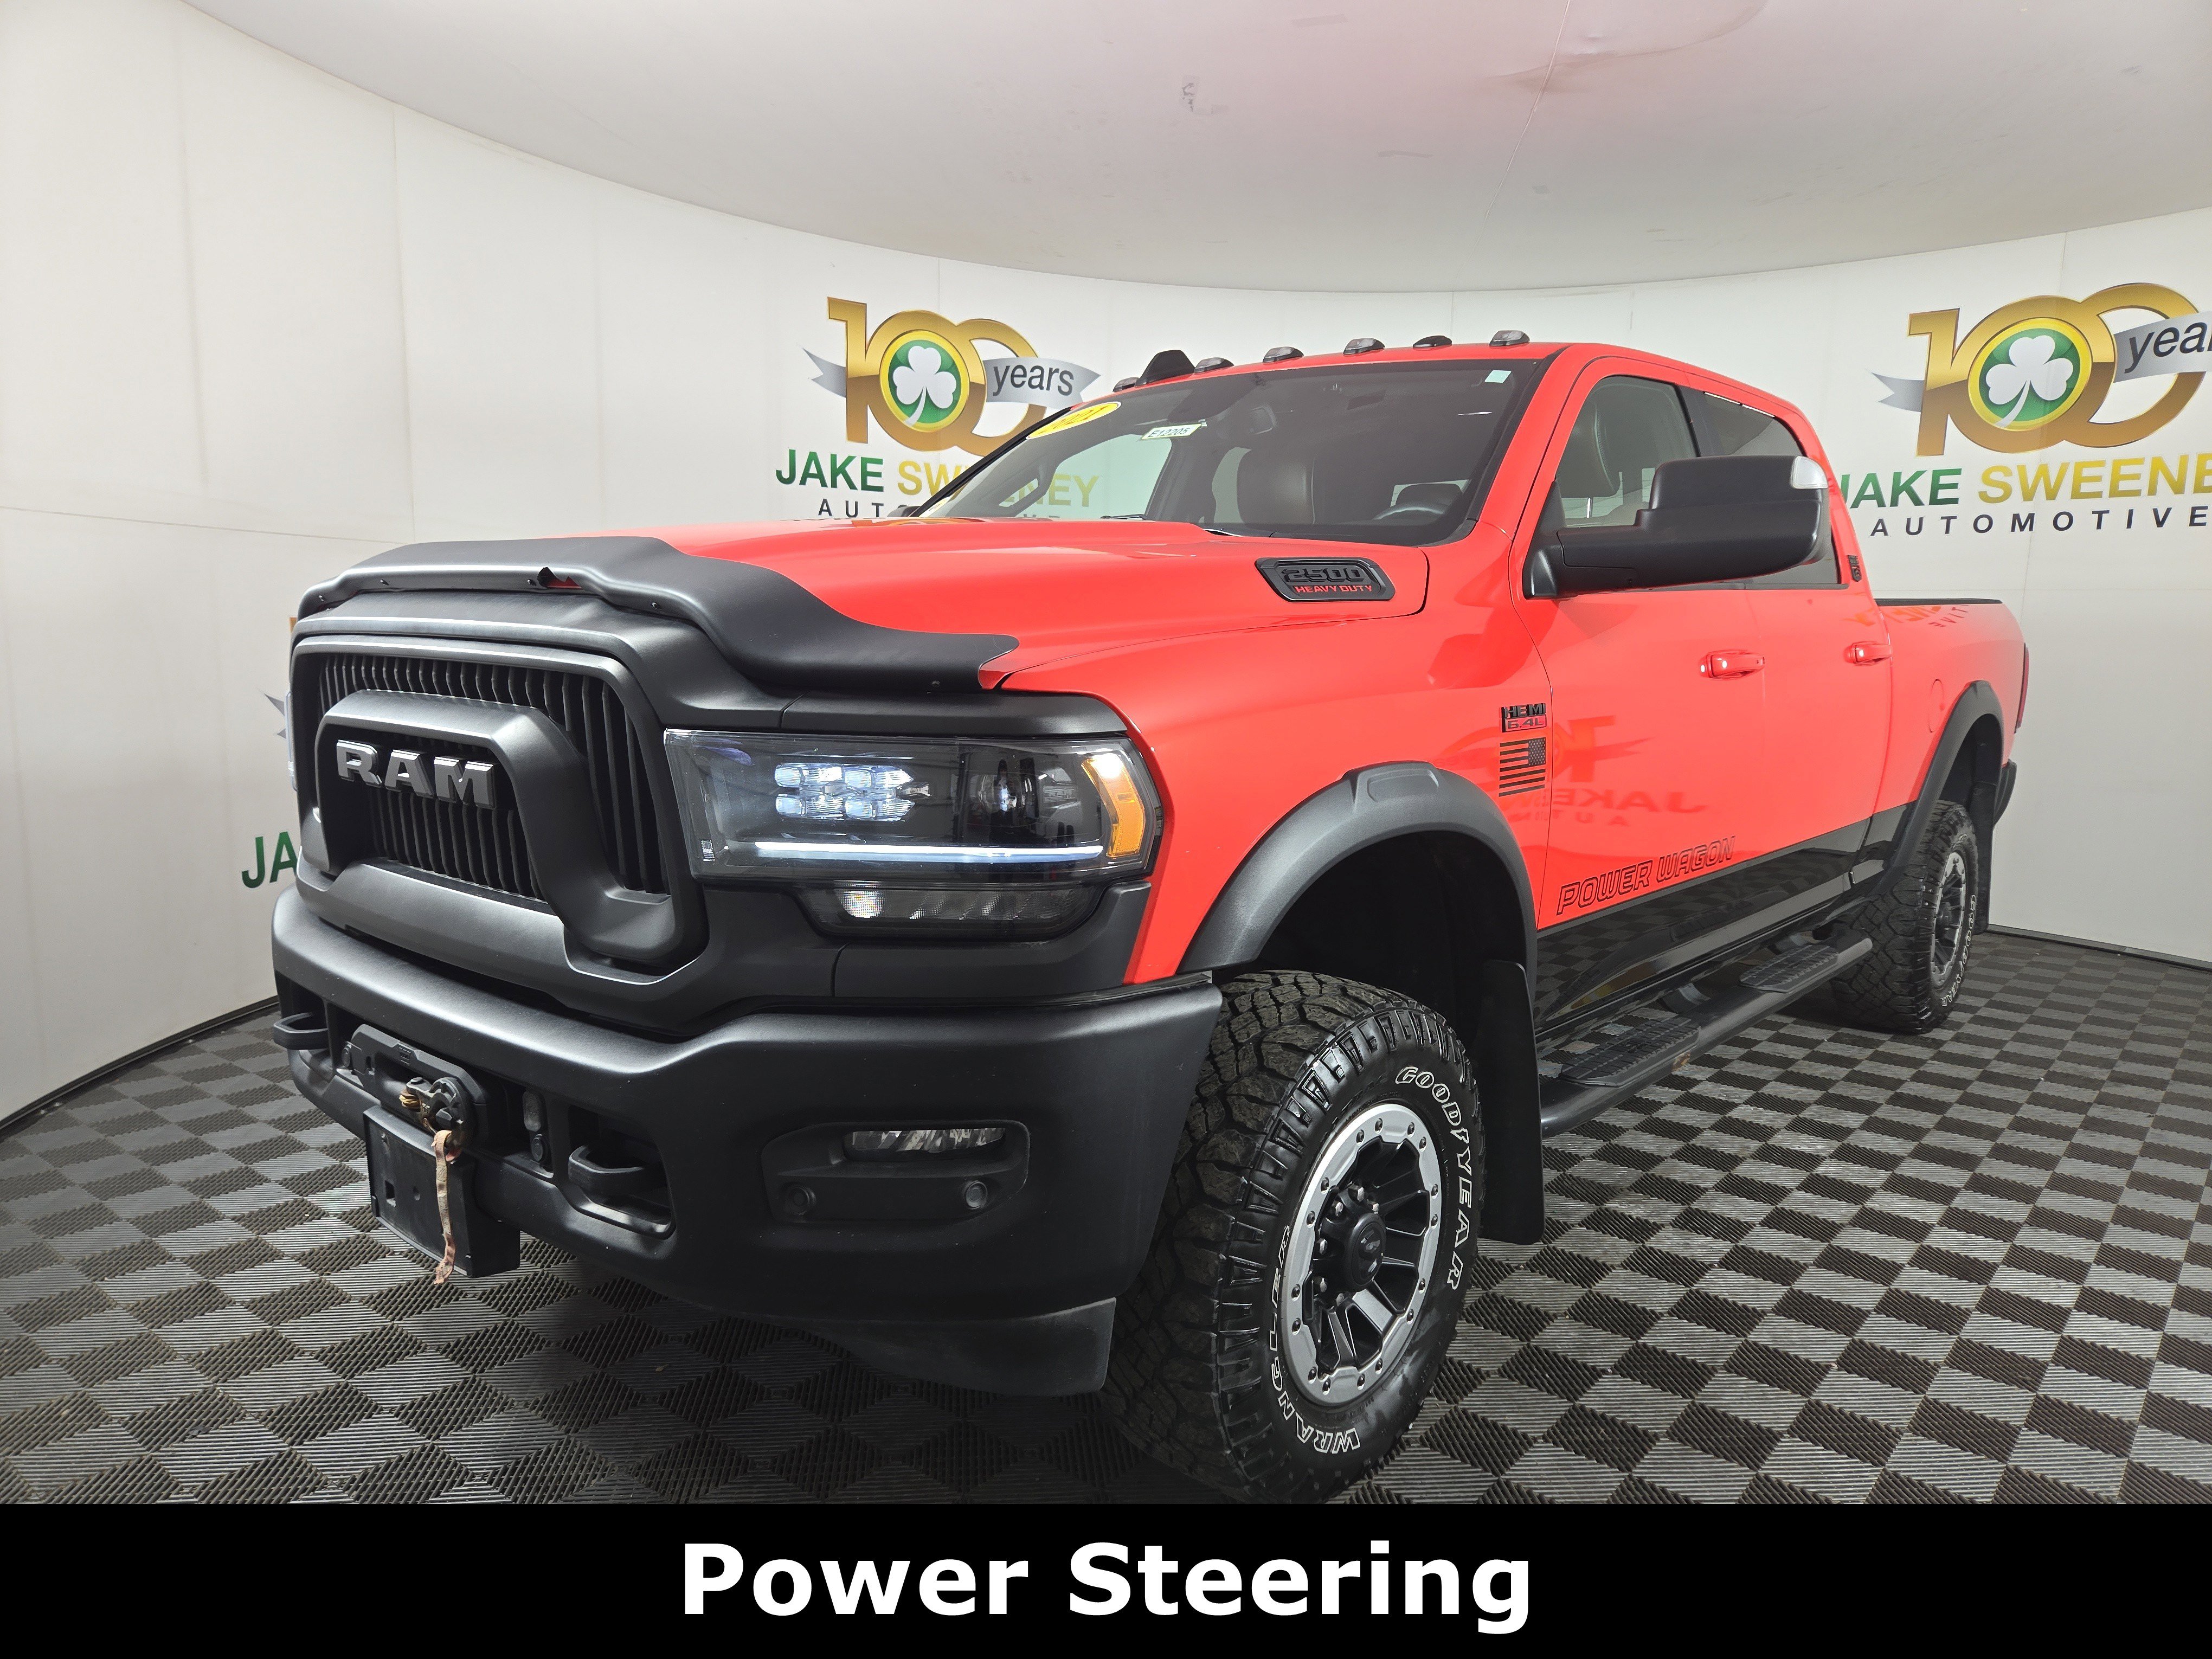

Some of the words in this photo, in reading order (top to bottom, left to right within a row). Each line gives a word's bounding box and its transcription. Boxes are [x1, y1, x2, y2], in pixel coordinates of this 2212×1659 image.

[2124, 321, 2212, 374] yea
[992, 363, 1075, 396] years
[1147, 427, 1189, 438] E12205
[776, 449, 884, 492] JAKE
[1870, 505, 2209, 537] AUTOMOTIVE
[1281, 567, 1366, 583] 2500
[1294, 585, 1338, 593] HEAVY
[1501, 703, 1546, 718] HEMI
[1507, 717, 1545, 729] 6.4L
[336, 740, 498, 809] RAM
[1556, 860, 1653, 915] POWER
[1656, 835, 1736, 883] WAGON
[1395, 1066, 1472, 1291] GOODYEAR
[1268, 1225, 1361, 1454] WRANGLER
